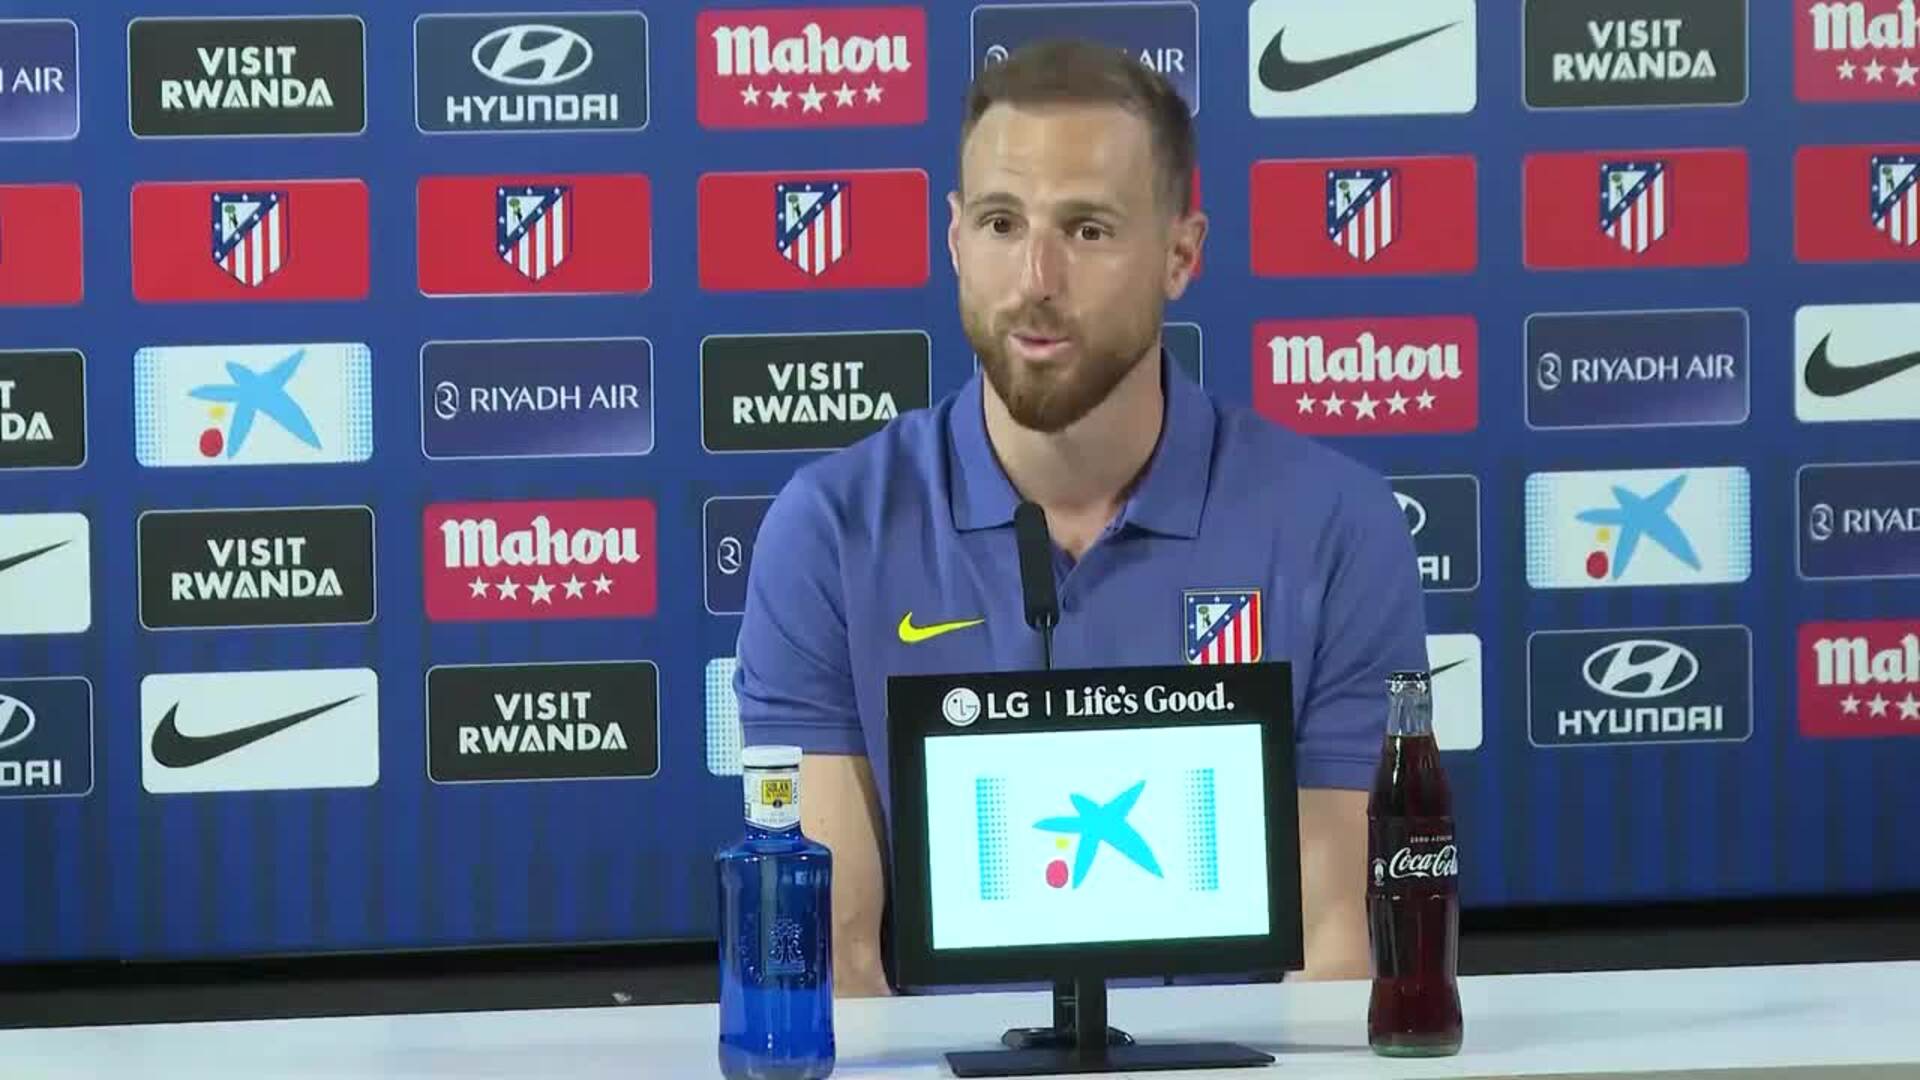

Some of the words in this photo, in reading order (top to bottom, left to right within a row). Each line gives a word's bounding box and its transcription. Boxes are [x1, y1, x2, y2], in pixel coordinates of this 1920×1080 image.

[1588, 20, 1682, 48] VISIT
[198, 47, 296, 76] VISIT
[712, 23, 911, 75] Mahou
[13, 68, 64, 92] AIR
[1554, 50, 1716, 81] RWANDA
[162, 79, 333, 108] RWANDA
[447, 94, 617, 122] HYUNDAI
[1268, 332, 1462, 384] Mahou
[1573, 357, 1678, 381] RIYADH
[1686, 355, 1734, 378] AIR
[768, 362, 863, 391] VISIT
[471, 386, 580, 411] RIYADH
[589, 385, 638, 408] AIR
[733, 393, 898, 423] RWANDA
[207, 538, 306, 567] VISIT
[440, 516, 640, 567] Mahou
[172, 569, 342, 600] RWANDA
[495, 692, 591, 720] VISIT
[988, 692, 1028, 718] LG
[1066, 686, 1138, 715] Life's
[1145, 682, 1234, 712] Good.
[1559, 706, 1722, 735] HYUNDAI
[460, 723, 627, 754] RWANDA
